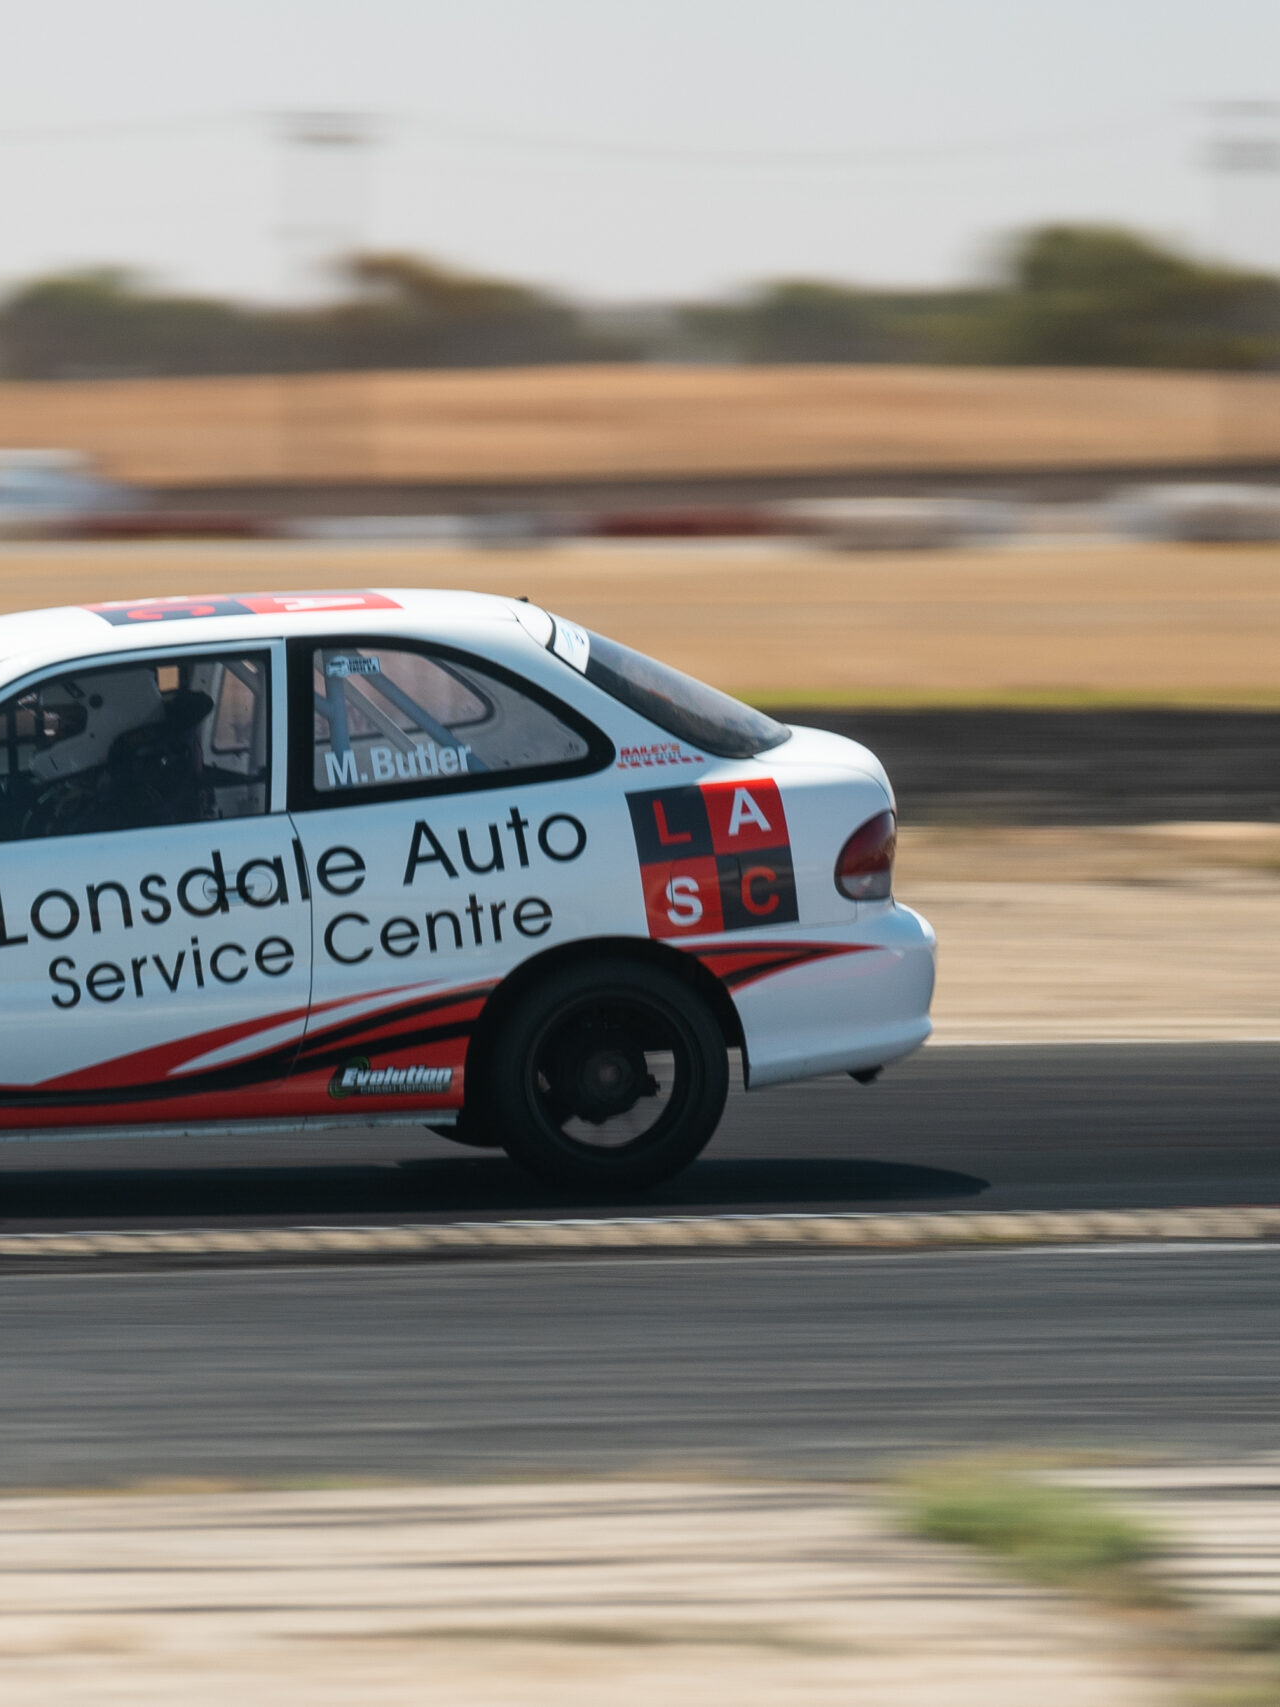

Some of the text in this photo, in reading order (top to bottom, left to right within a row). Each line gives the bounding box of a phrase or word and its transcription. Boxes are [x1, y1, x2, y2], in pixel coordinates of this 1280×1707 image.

[324, 737, 472, 787] M. Butler
[402, 805, 587, 886] Auto
[653, 786, 772, 846] L A
[664, 866, 780, 928] S C
[48, 895, 553, 1010] Service Centre
[341, 1065, 453, 1087] Evolution
